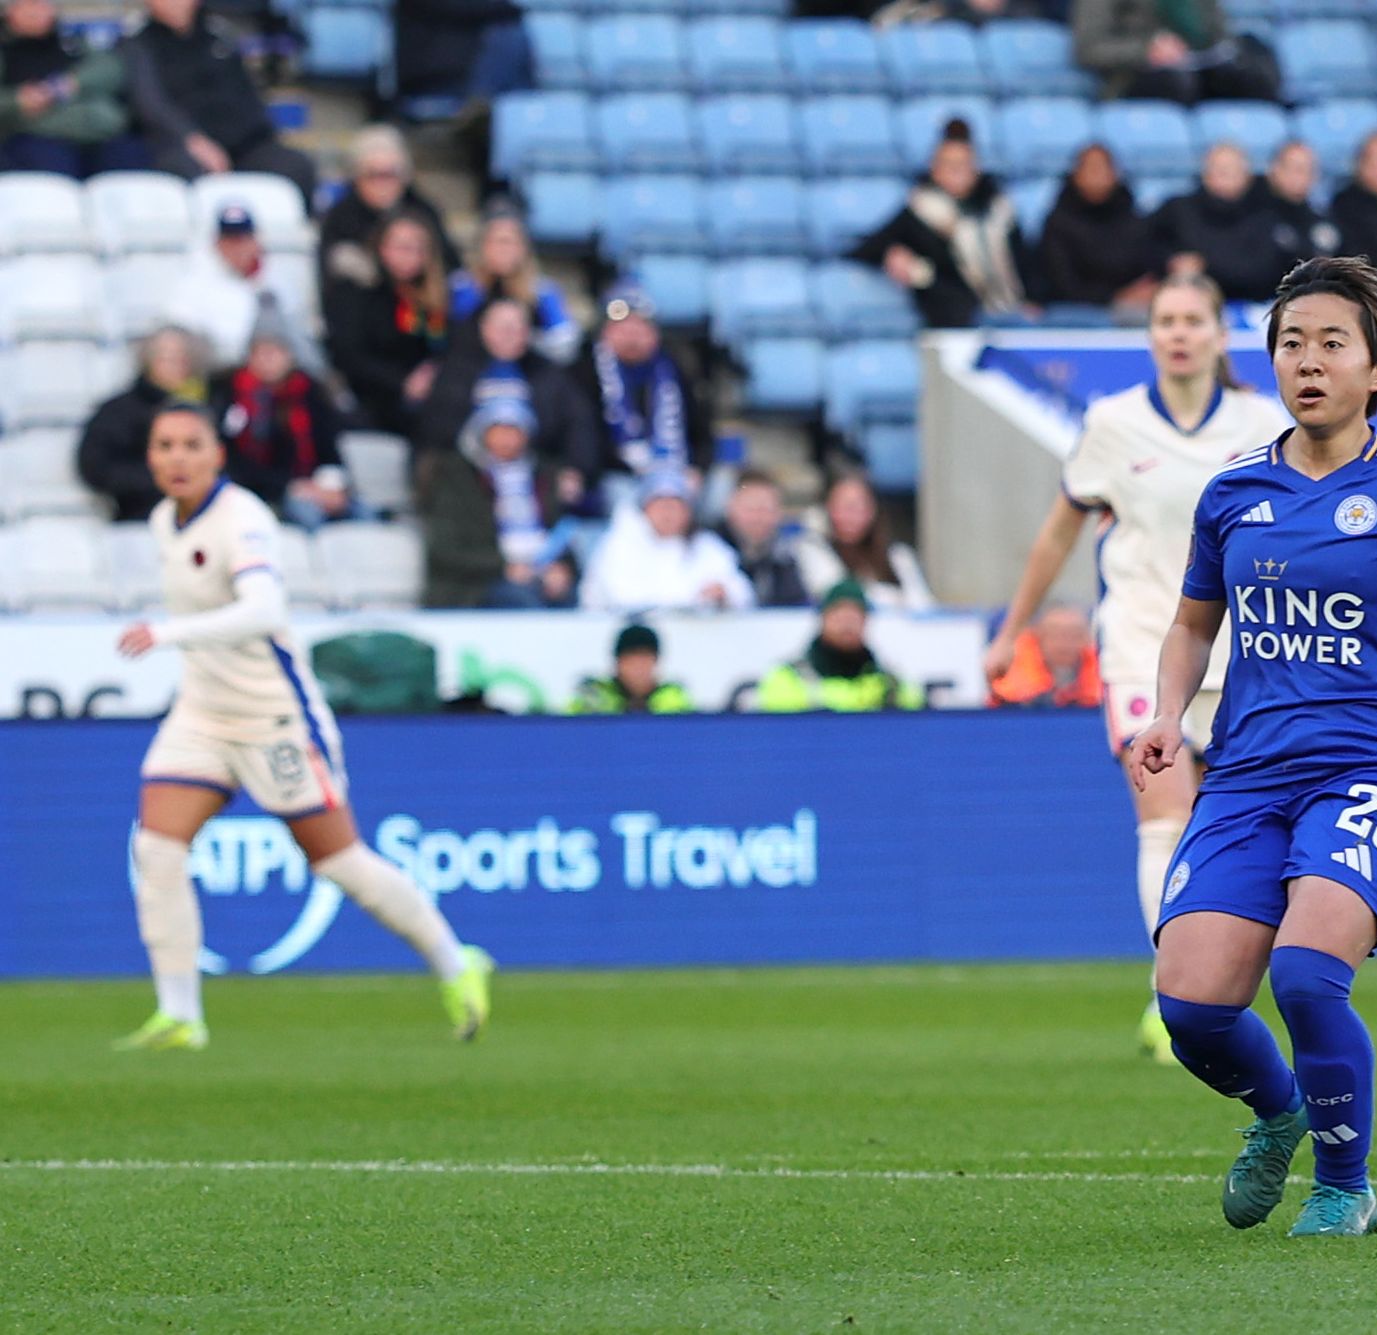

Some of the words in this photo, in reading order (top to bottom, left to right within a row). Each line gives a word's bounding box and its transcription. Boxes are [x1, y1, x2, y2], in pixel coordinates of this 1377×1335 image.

[1234, 585, 1365, 631] KING
[1239, 631, 1362, 665] POWER
[376, 813, 601, 906] Sports
[610, 807, 817, 890] Travel
[1306, 1093, 1354, 1106] LCFC
